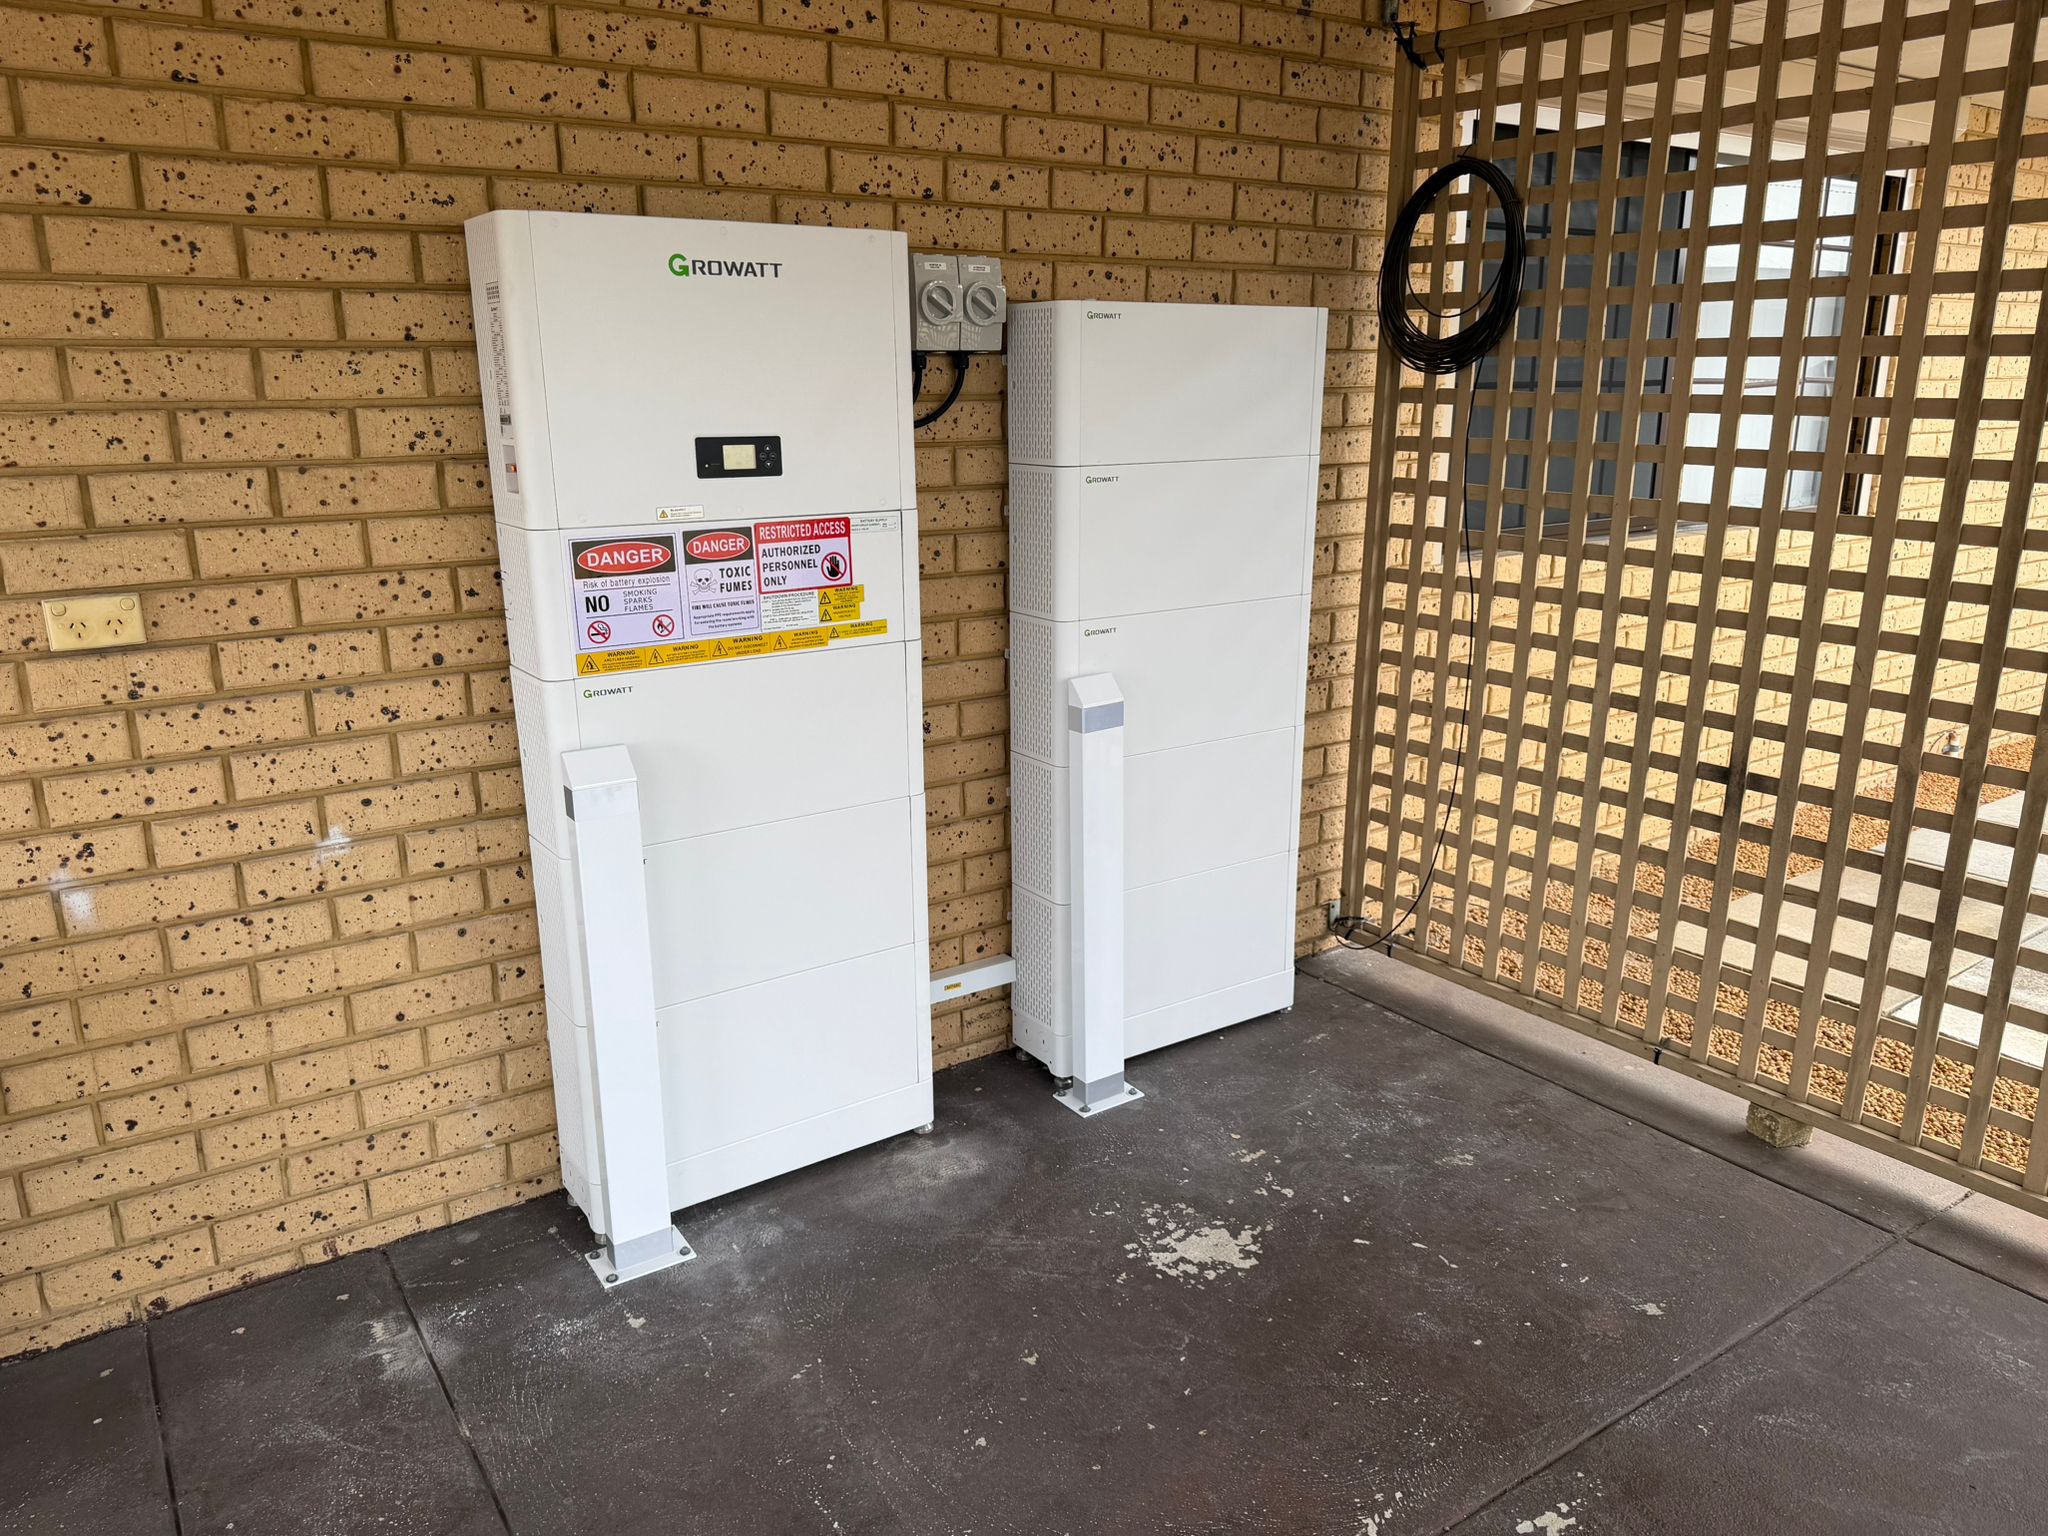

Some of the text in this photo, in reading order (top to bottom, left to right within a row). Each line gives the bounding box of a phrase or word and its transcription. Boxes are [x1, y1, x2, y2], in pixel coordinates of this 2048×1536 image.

[668, 253, 783, 278] GROWATT
[1086, 310, 1122, 320] GROWATT
[1085, 475, 1119, 484] GROWATT
[759, 523, 813, 541] RESTRICTED
[813, 520, 846, 537] ACCESS
[693, 537, 745, 554] DANGER
[761, 544, 821, 558] AUTHORIZED
[587, 548, 663, 567] DANGER
[719, 565, 751, 579] TOXIC
[762, 558, 818, 573] PERSONNEL
[583, 575, 671, 590] Risk of battery explosion
[720, 580, 752, 593] FUMES
[763, 575, 788, 587] ONLY
[622, 588, 657, 598] SMOKING
[585, 594, 610, 613] NO
[623, 596, 653, 606] SPARKS
[624, 603, 654, 613] FLAMES
[1084, 627, 1117, 637] GROWATT
[733, 635, 763, 644] WARNING
[672, 644, 699, 652] WARNING
[583, 685, 633, 699] GROWATT
